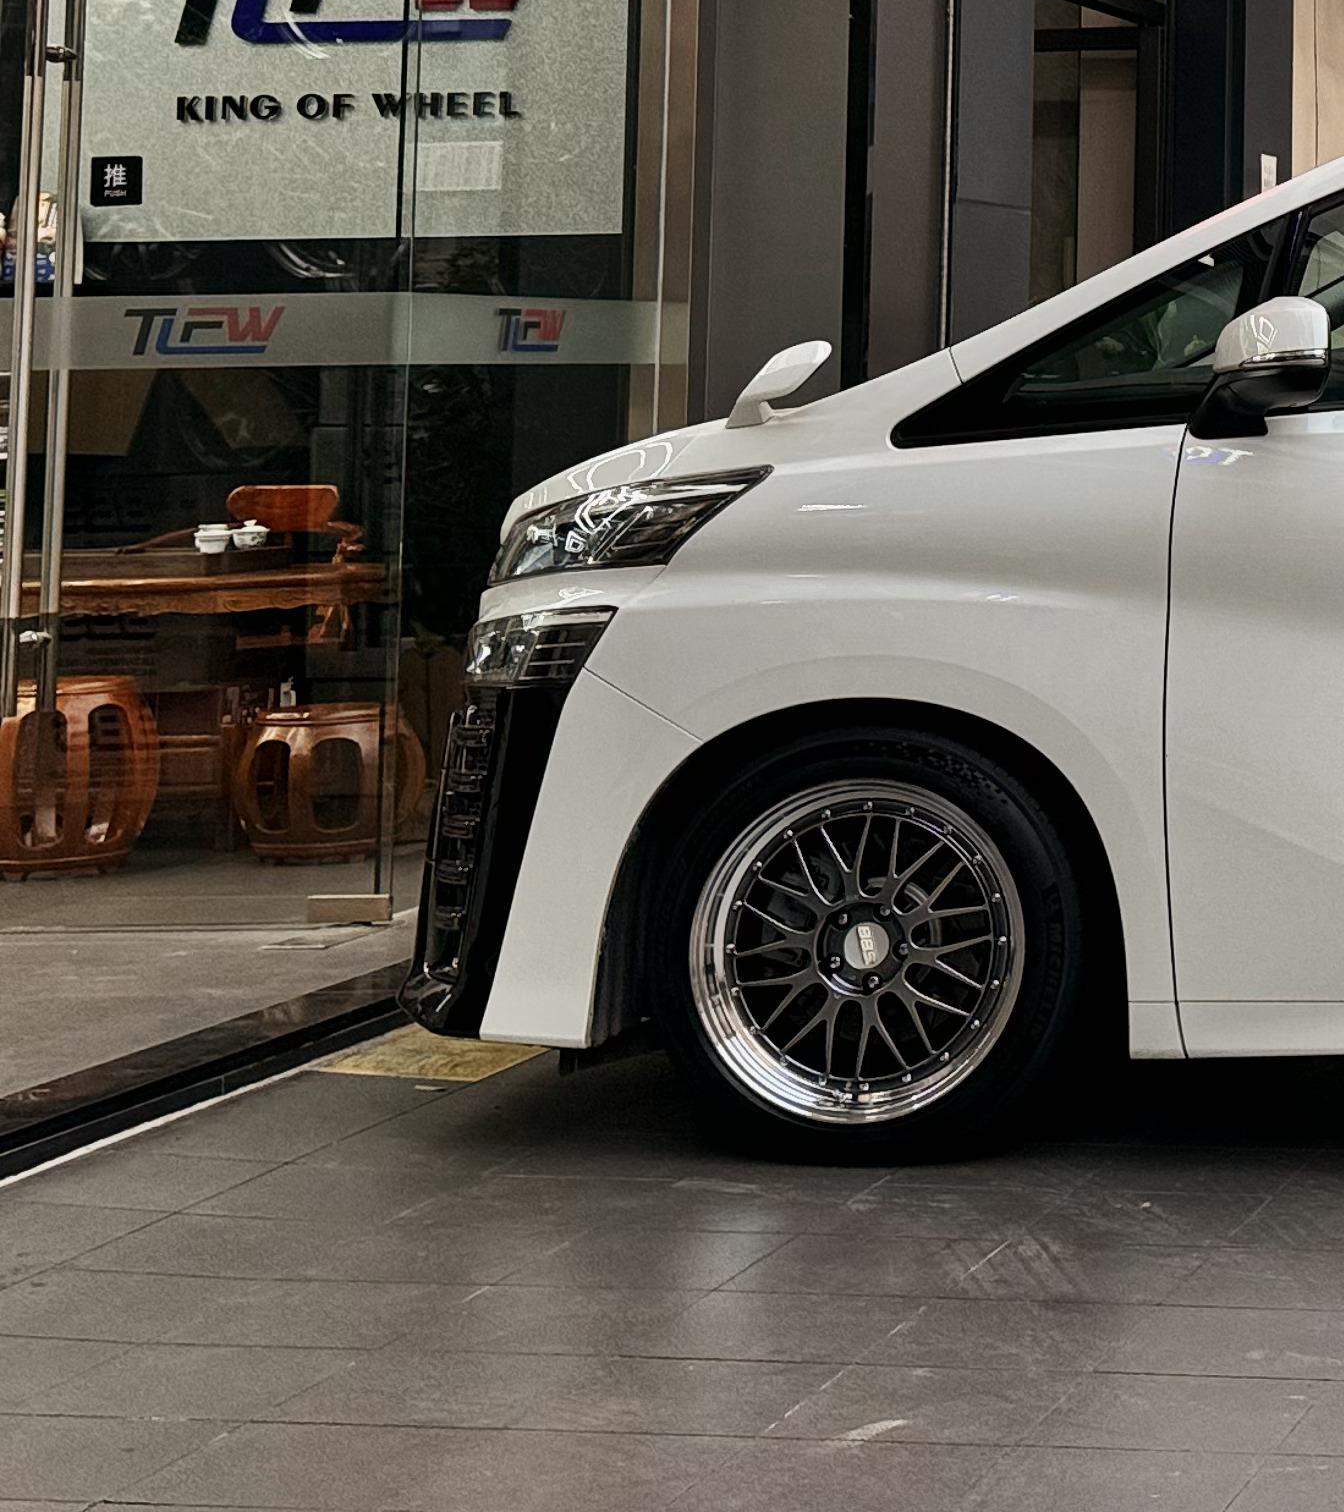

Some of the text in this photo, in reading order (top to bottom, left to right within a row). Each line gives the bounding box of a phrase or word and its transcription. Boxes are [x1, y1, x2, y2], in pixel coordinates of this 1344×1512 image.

[176, 90, 522, 122] KING OF WHEEL
[103, 163, 128, 188] 推
[857, 925, 876, 966] BBS
